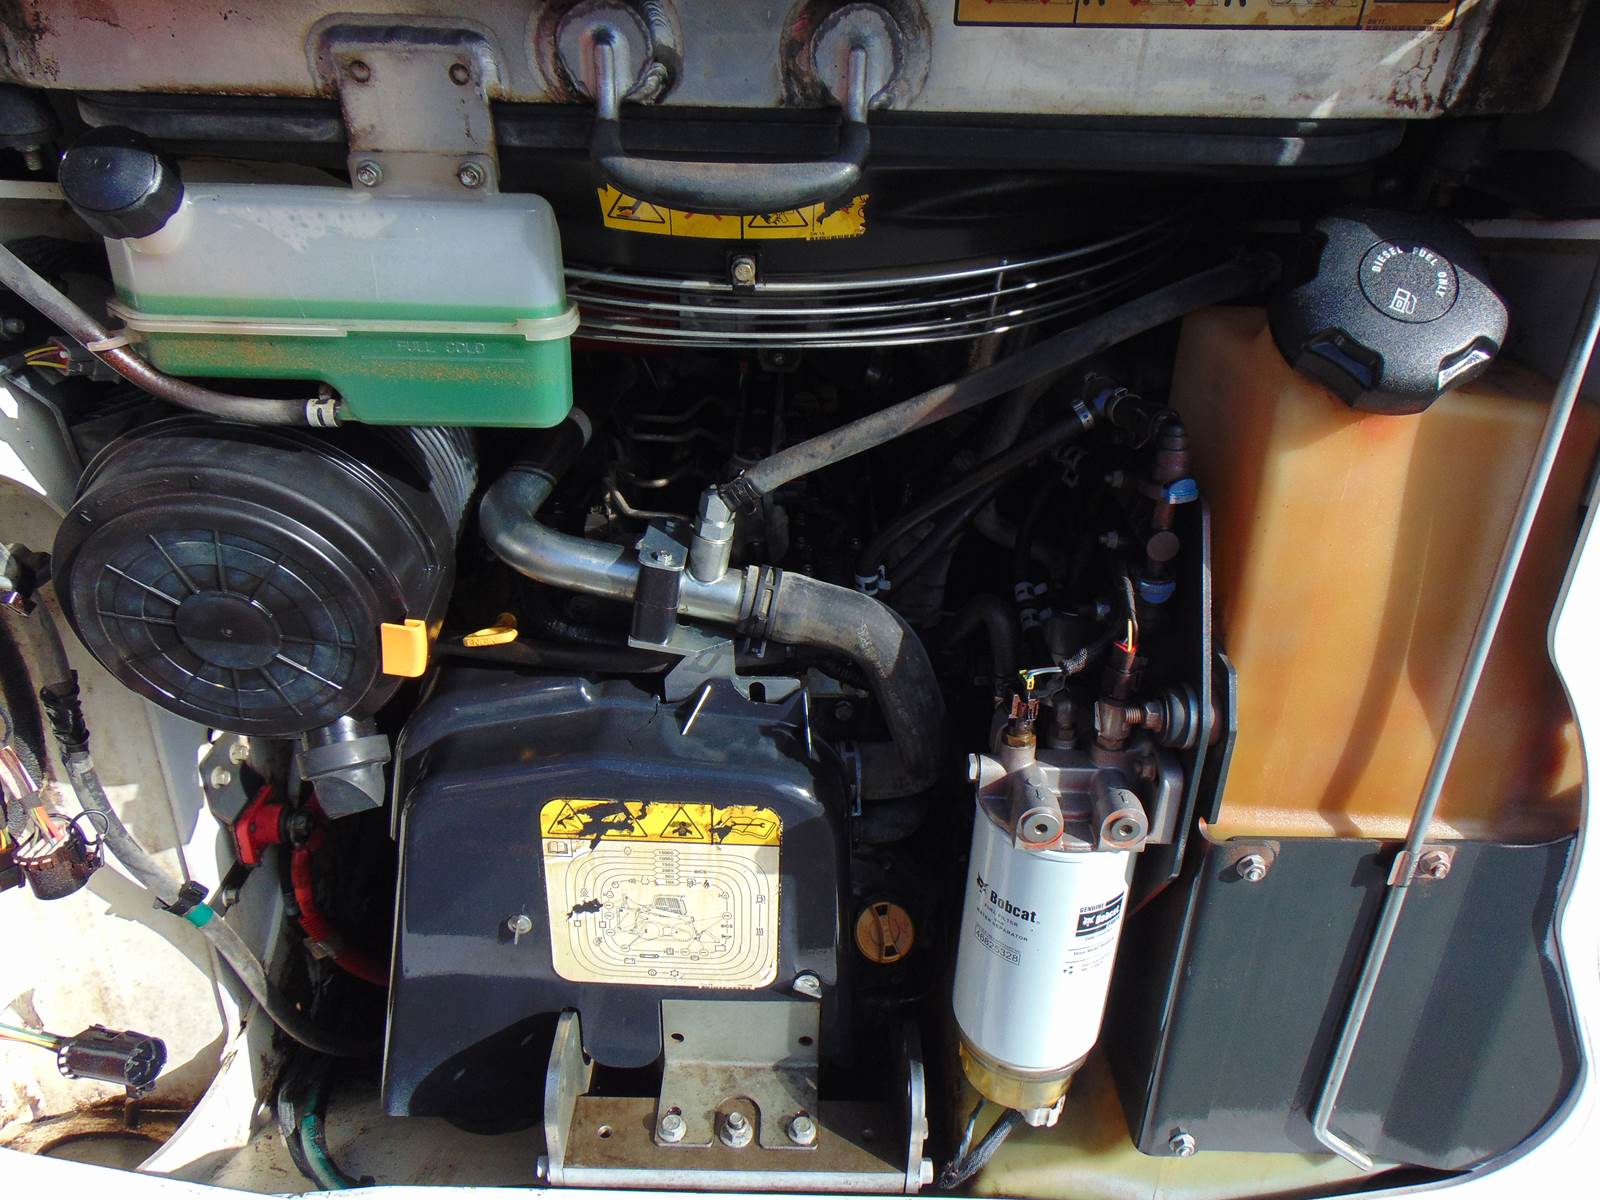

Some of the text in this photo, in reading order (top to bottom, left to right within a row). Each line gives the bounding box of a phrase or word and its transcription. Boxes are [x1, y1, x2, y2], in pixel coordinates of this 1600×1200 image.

[1371, 245, 1449, 298] DIESEL FUEL ONLY
[397, 340, 486, 354] FULL COLD
[990, 889, 1036, 923] Bobcat
[1095, 905, 1120, 925] Bobcat
